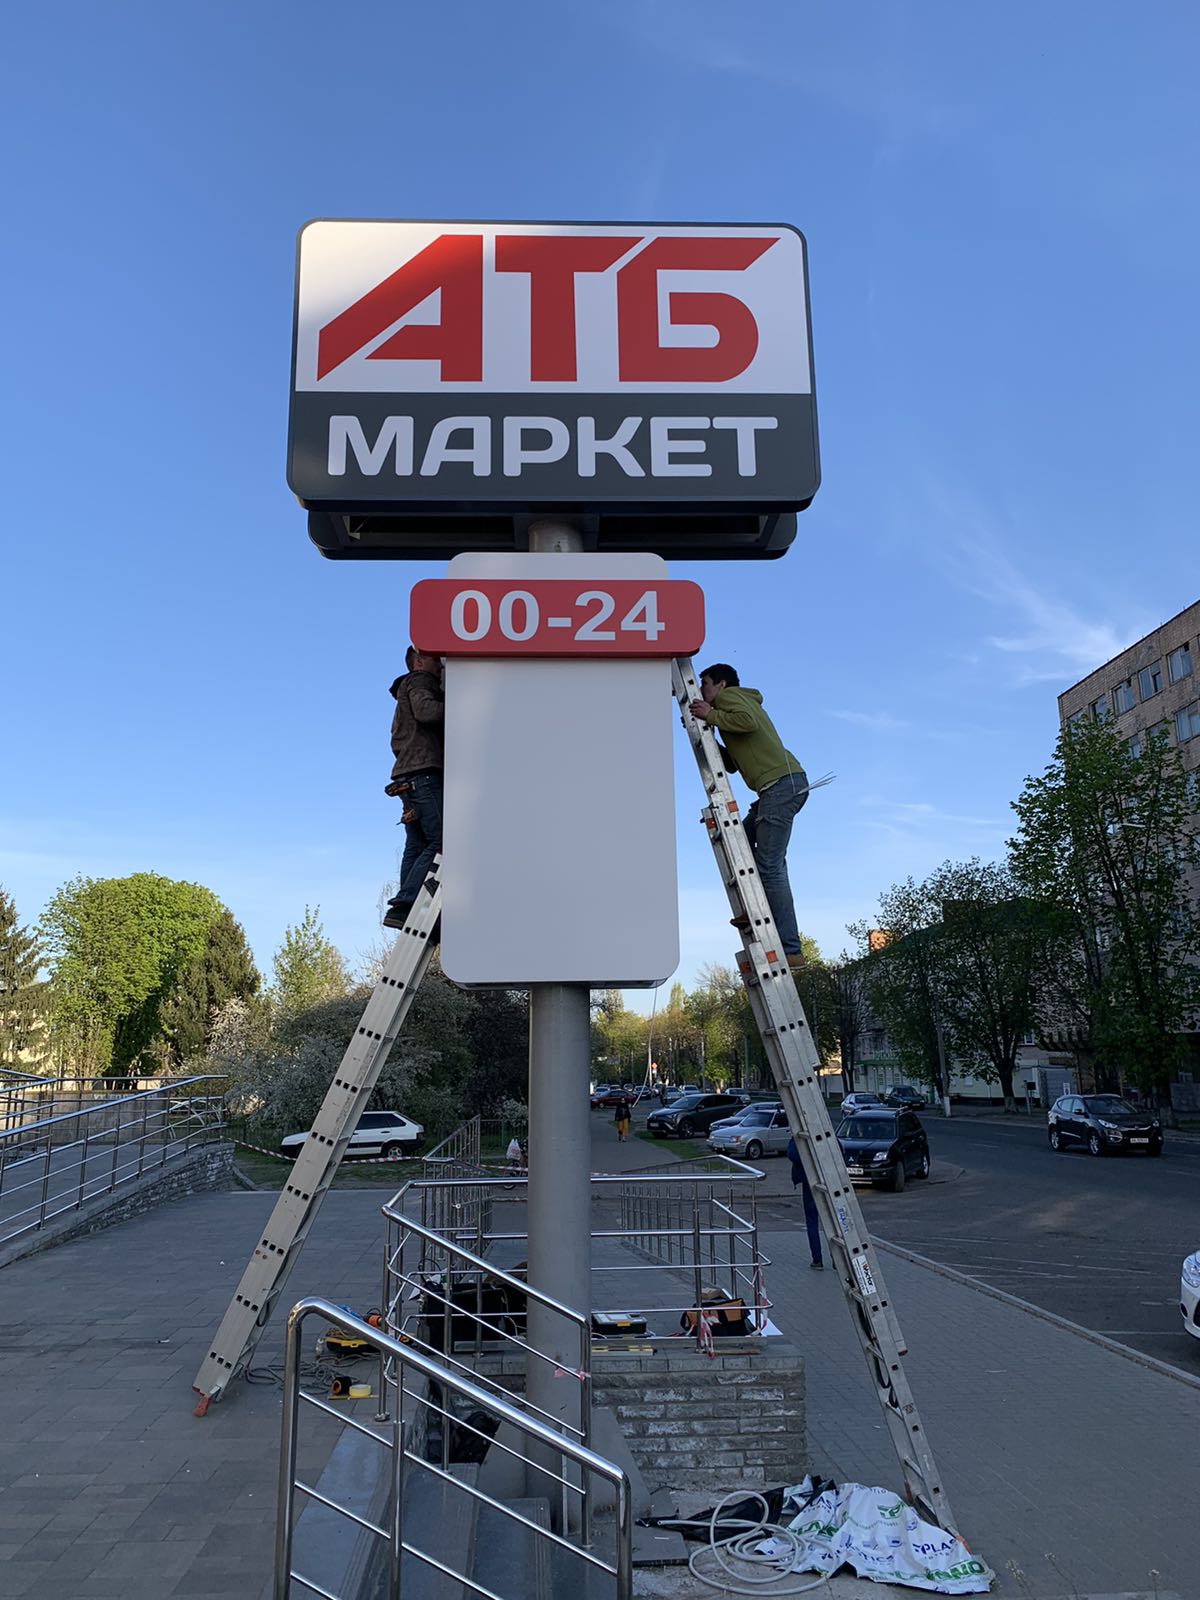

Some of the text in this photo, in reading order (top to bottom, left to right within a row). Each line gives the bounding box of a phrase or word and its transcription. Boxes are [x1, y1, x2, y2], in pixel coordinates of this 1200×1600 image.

[317, 234, 781, 383] АТБ
[327, 415, 779, 477] МАРКЕТ
[449, 590, 667, 641] 00-24
